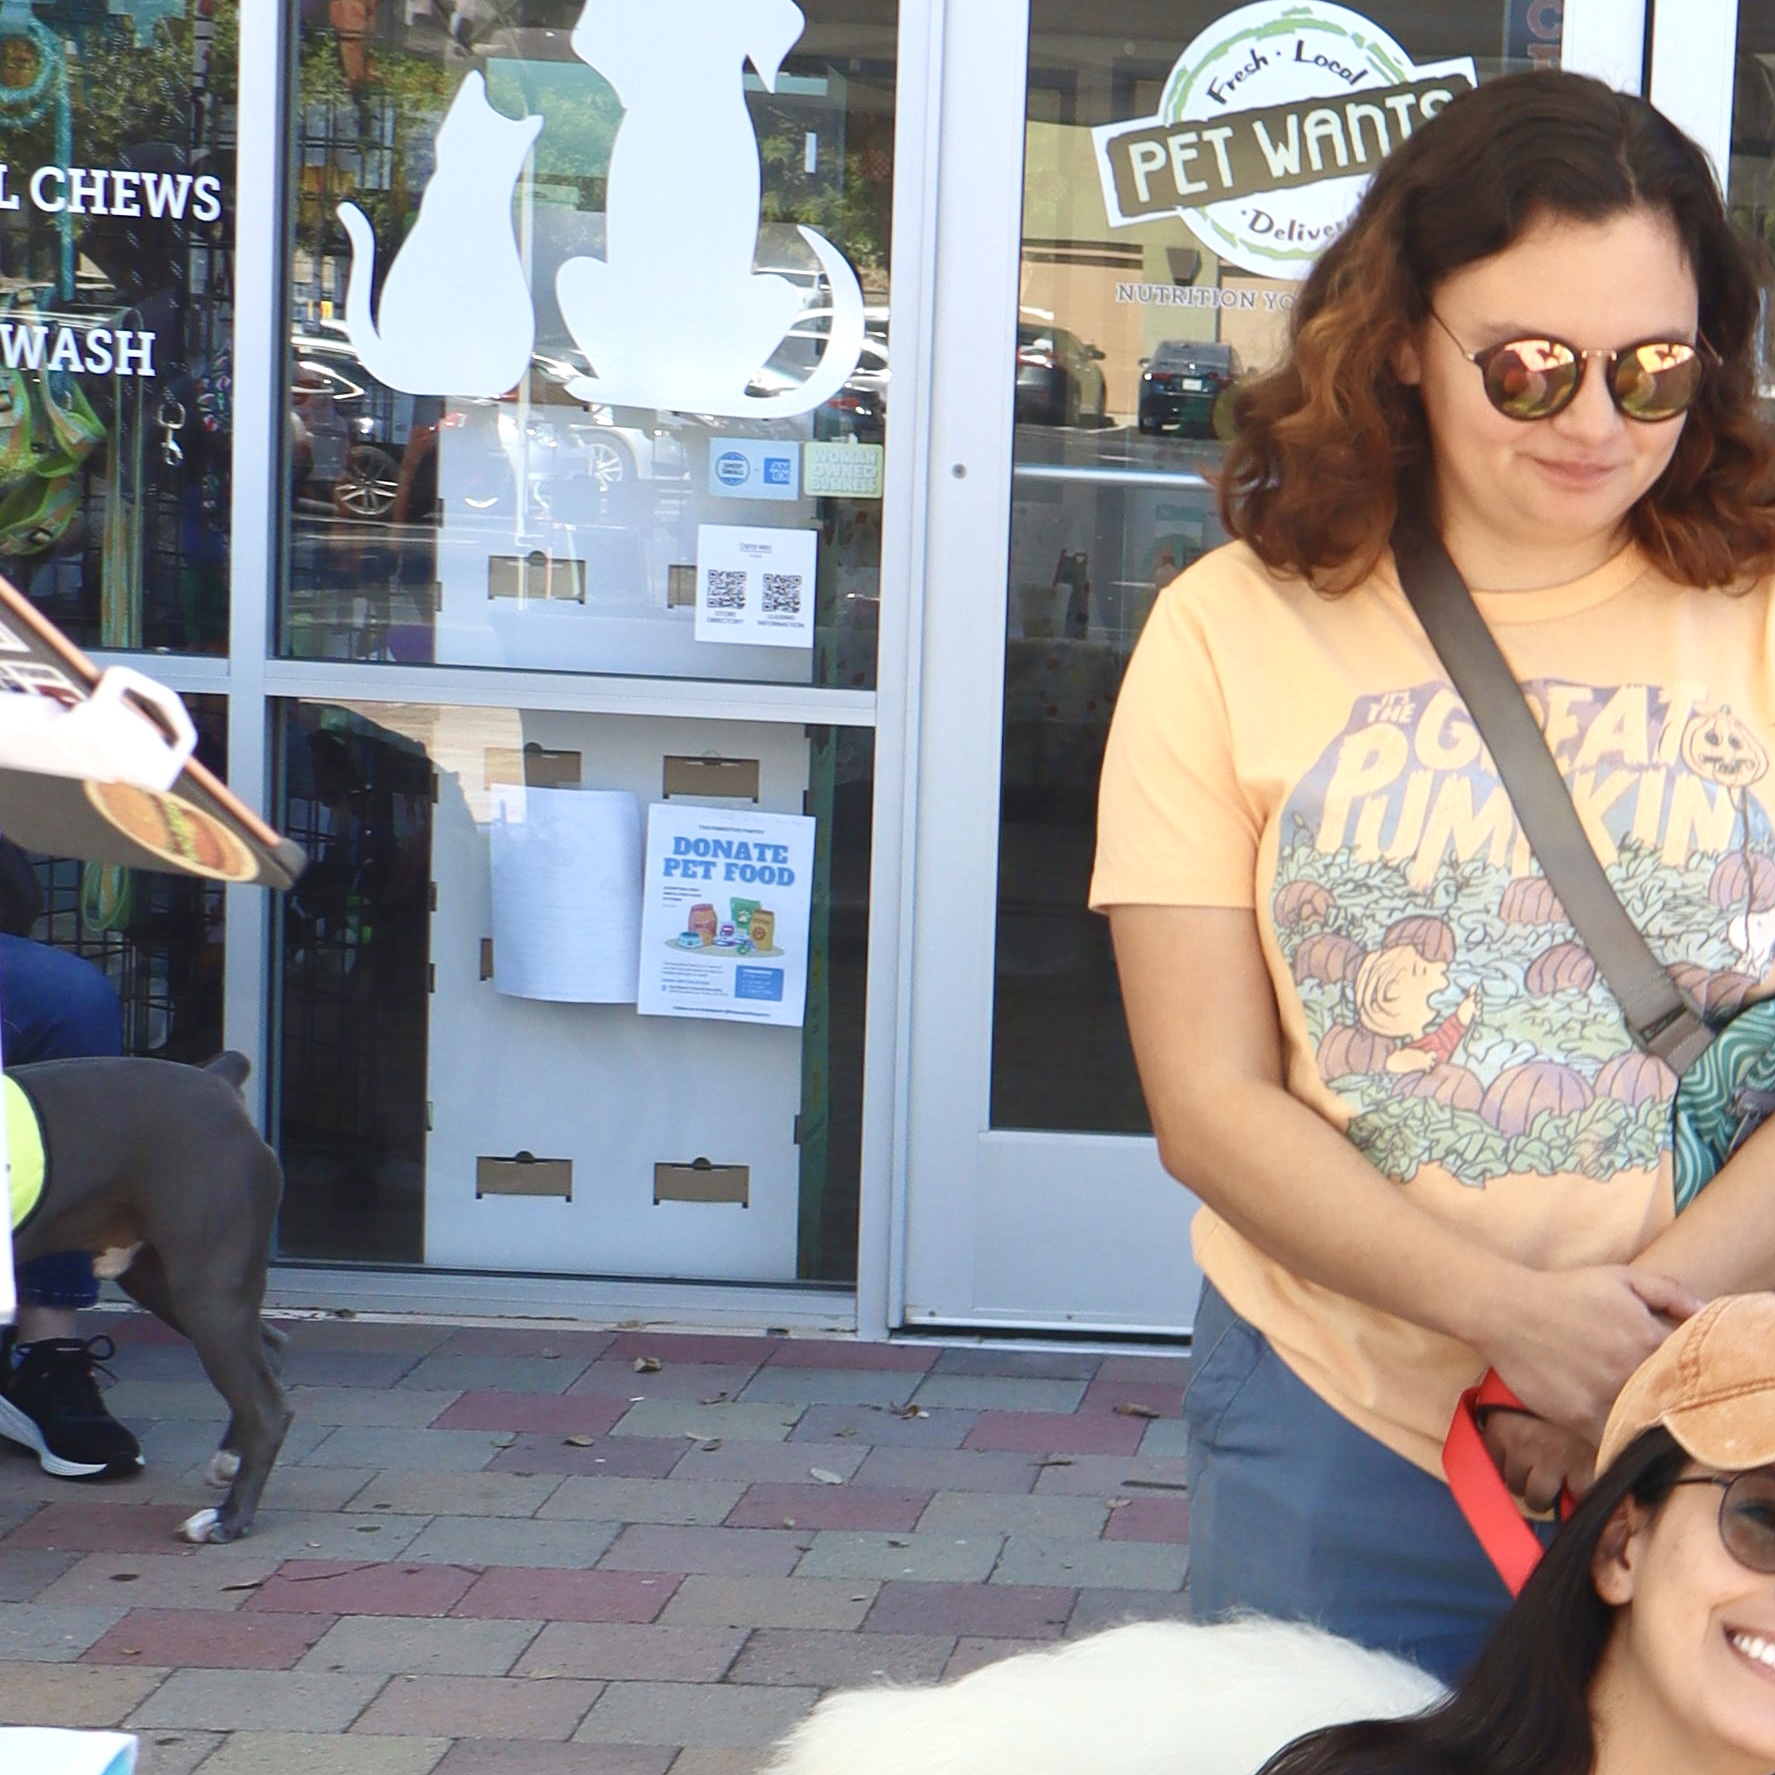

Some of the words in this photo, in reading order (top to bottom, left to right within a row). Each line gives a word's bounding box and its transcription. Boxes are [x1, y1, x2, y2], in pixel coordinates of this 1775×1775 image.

[1205, 47, 1269, 106] Fresh
[1294, 39, 1369, 87] Local
[1128, 126, 1234, 202] PET
[30, 165, 221, 222] CHEWS
[1116, 282, 1257, 311] NUTRITION
[0, 322, 156, 377] WASH
[813, 462, 878, 478] OWNED
[814, 449, 877, 464] WOMAN
[812, 477, 877, 493] BUSINESS
[1367, 701, 1417, 724] THE
[1414, 684, 1708, 778] GEAT
[672, 836, 789, 865] DONATE
[662, 857, 717, 880] PET
[723, 862, 796, 887] FOOD
